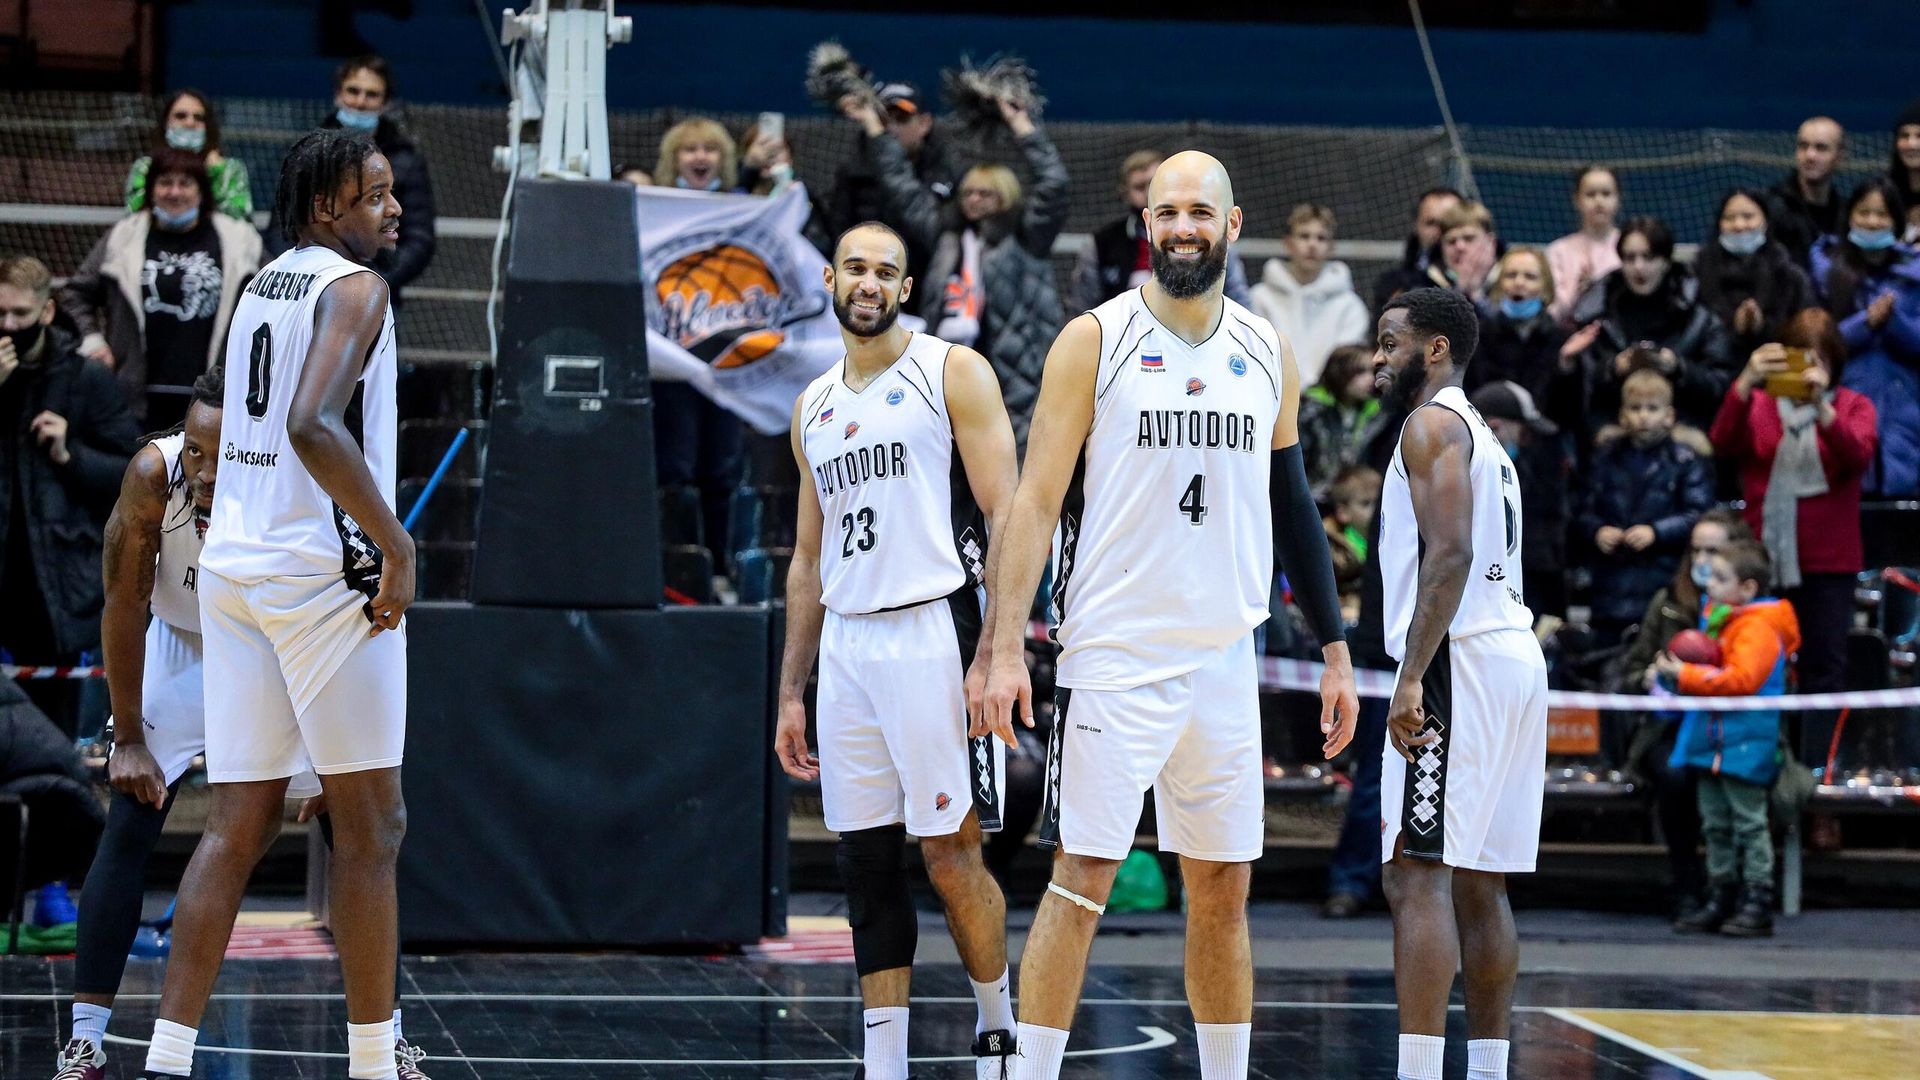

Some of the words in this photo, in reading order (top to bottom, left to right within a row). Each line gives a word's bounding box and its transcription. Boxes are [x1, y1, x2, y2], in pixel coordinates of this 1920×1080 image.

[246, 321, 273, 422] 0
[1137, 409, 1256, 454] AVTODOR
[816, 441, 908, 498] AVTODOR
[1178, 473, 1208, 527] 4
[841, 506, 878, 560] 23
